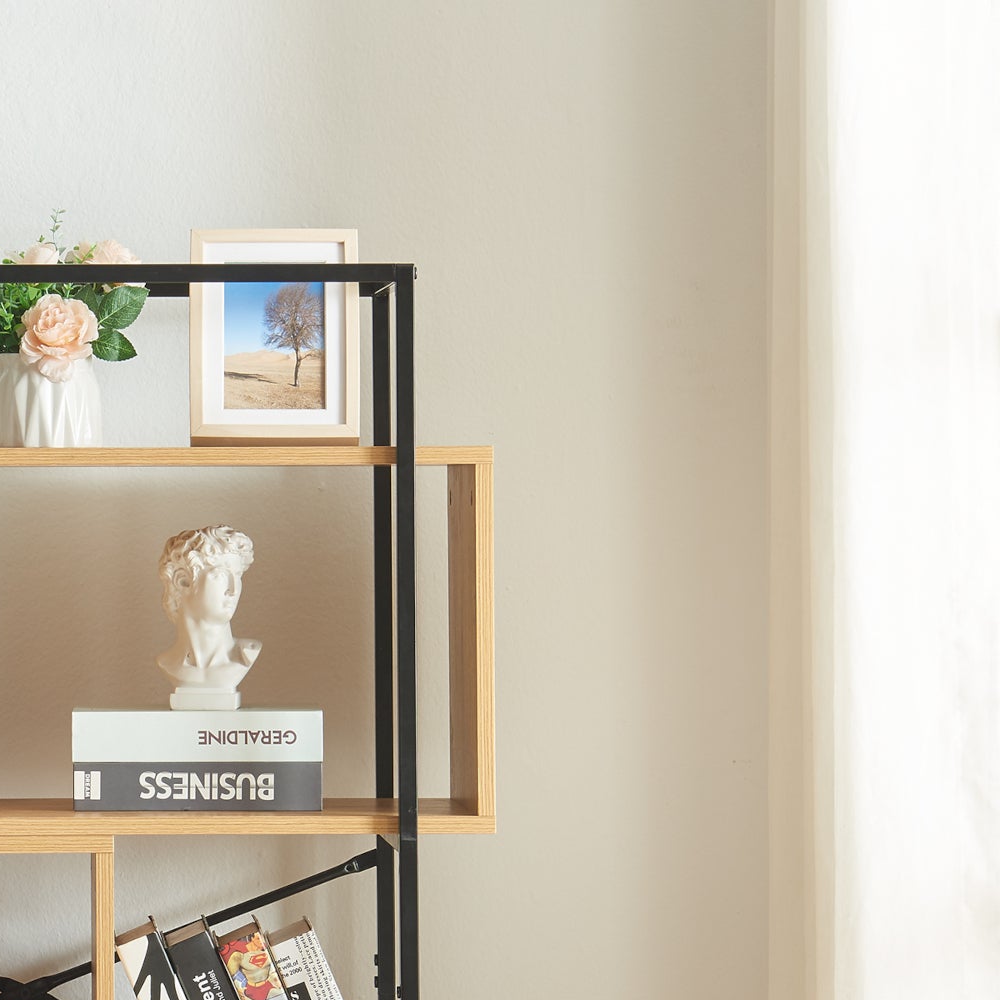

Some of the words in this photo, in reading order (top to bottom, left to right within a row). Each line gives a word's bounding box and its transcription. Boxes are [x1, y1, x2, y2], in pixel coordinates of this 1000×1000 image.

[198, 730, 297, 745] GERALDINE
[139, 771, 275, 800] BUSINESS
[206, 969, 221, 991] Juliet
